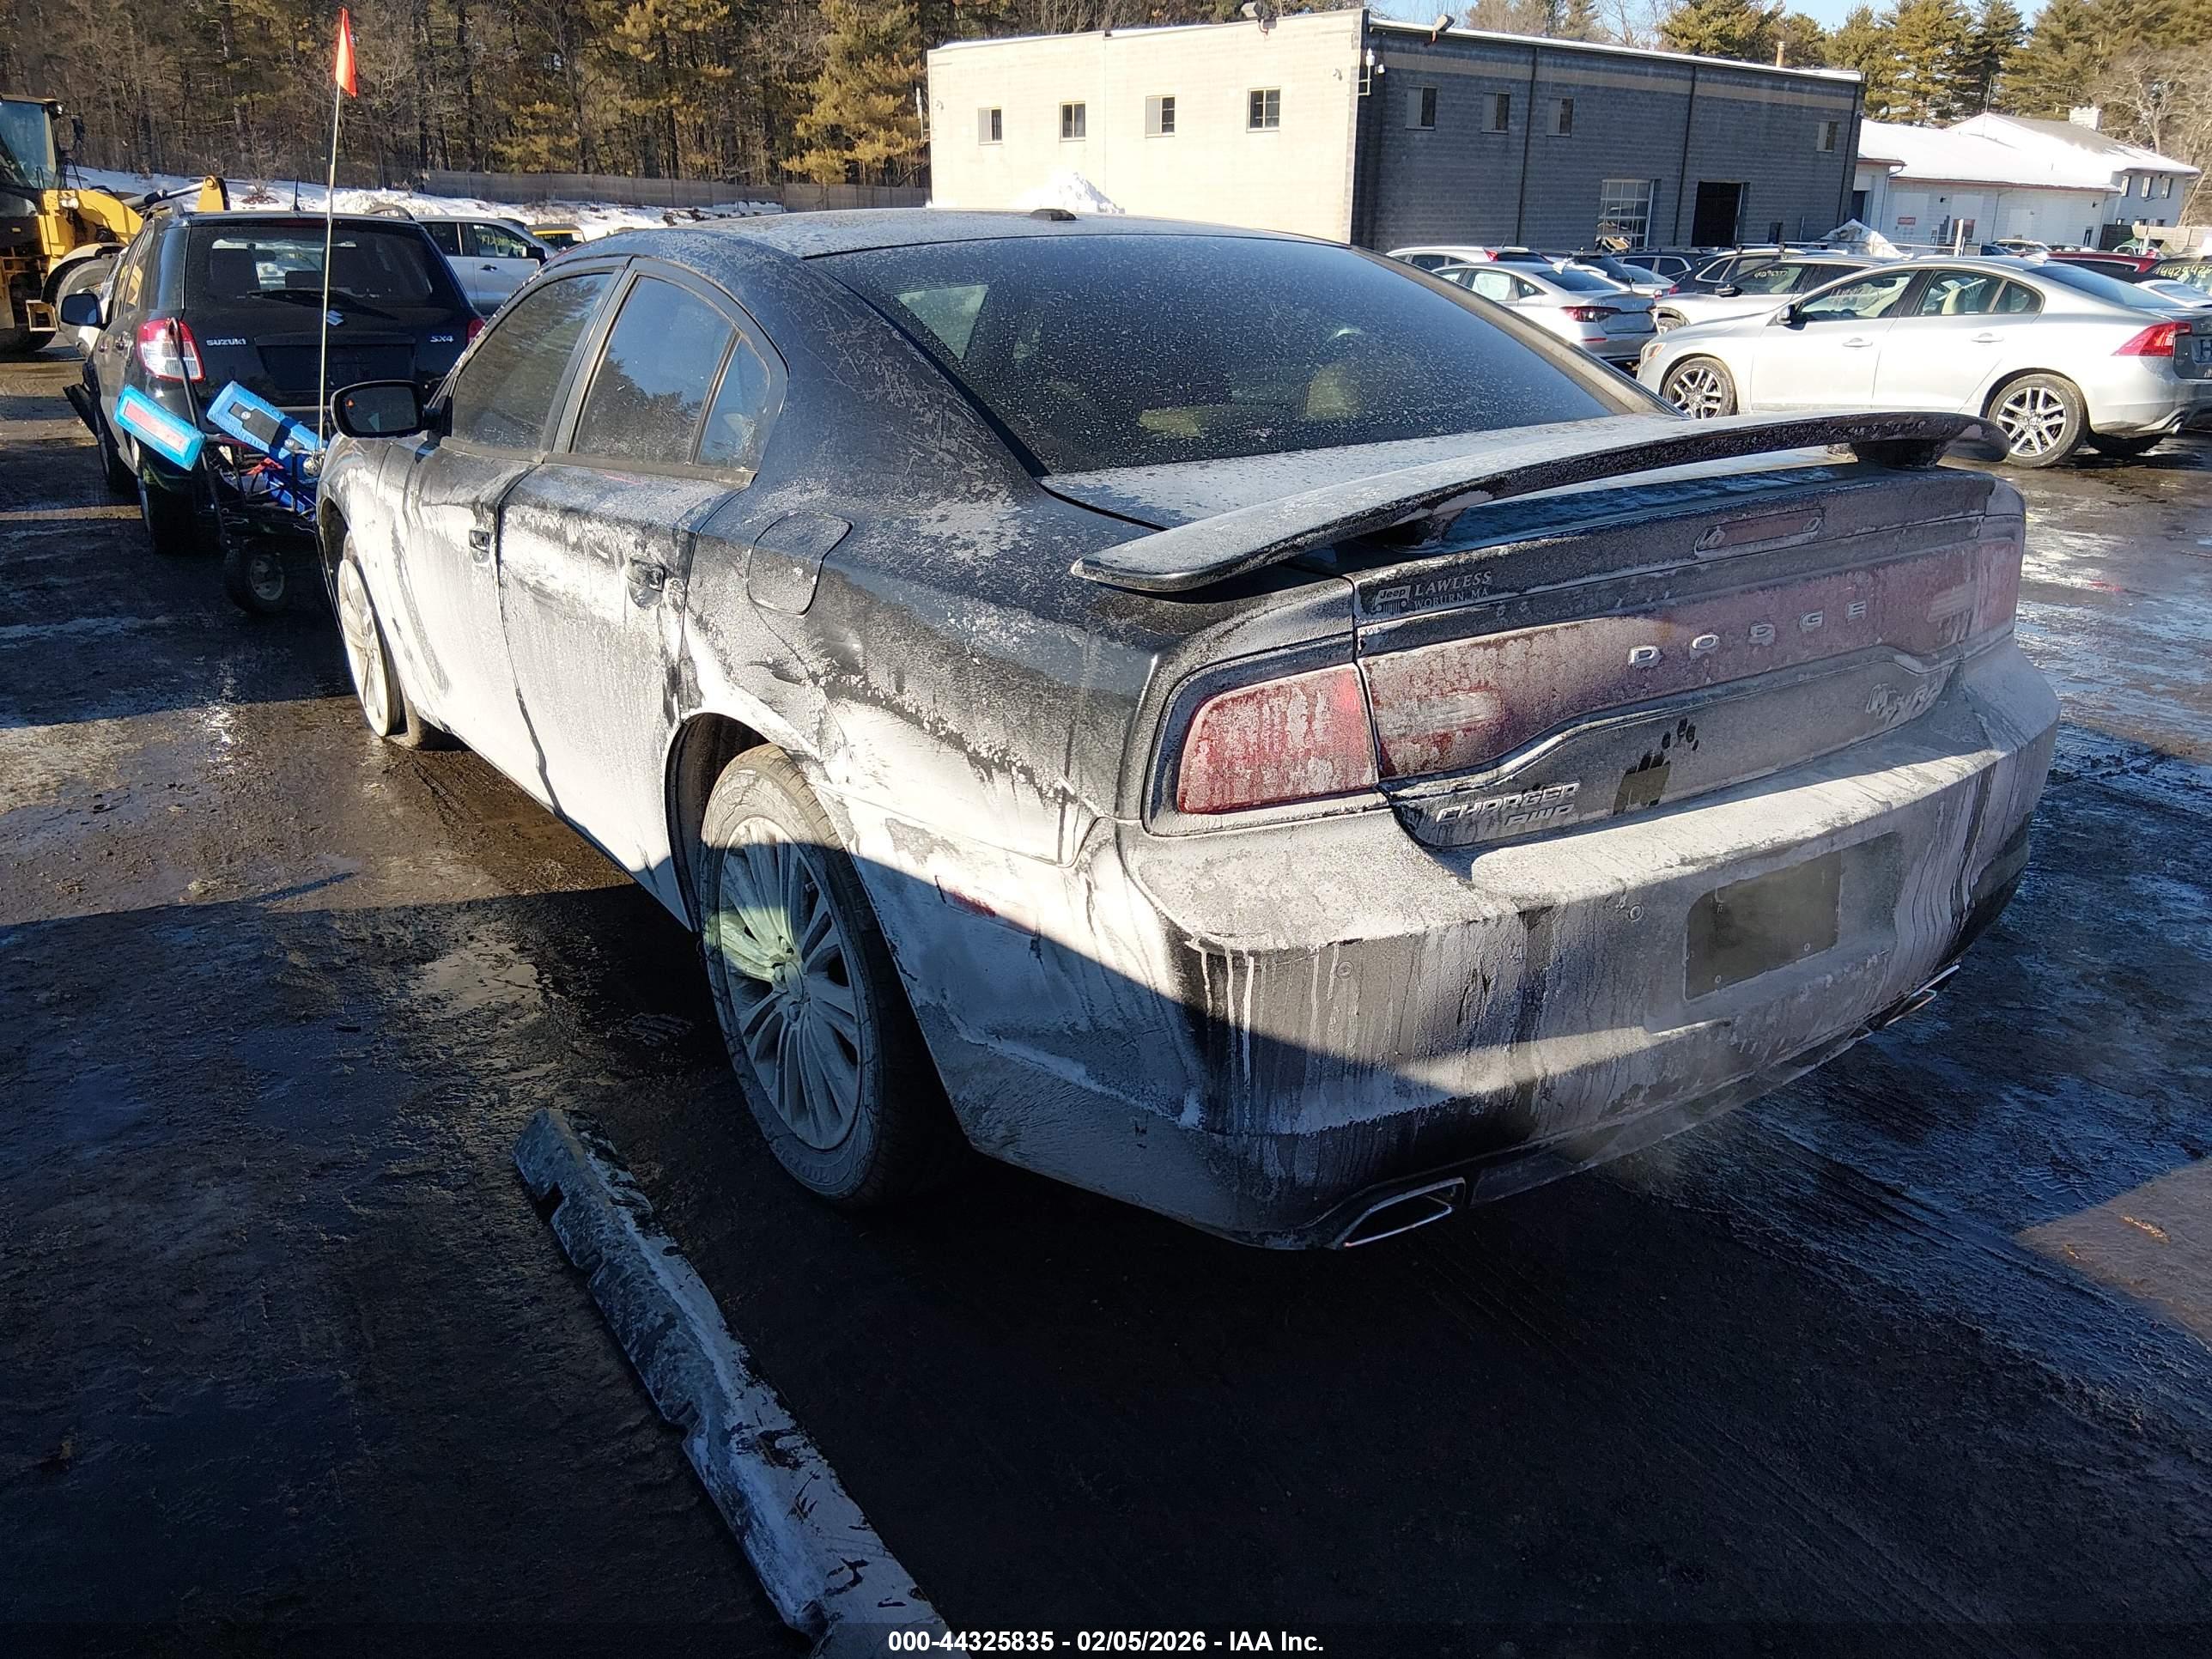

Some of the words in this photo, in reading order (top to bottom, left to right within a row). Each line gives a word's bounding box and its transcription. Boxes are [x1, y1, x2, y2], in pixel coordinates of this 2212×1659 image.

[206, 337, 246, 346] SUZUKI
[1380, 588, 1407, 600] Jeep
[1414, 570, 1492, 597] LAWLESS
[1471, 587, 1489, 599] MA
[1628, 601, 1868, 667] DODGE
[1436, 782, 1581, 823] CHARGER
[1504, 803, 1576, 827] AWD
